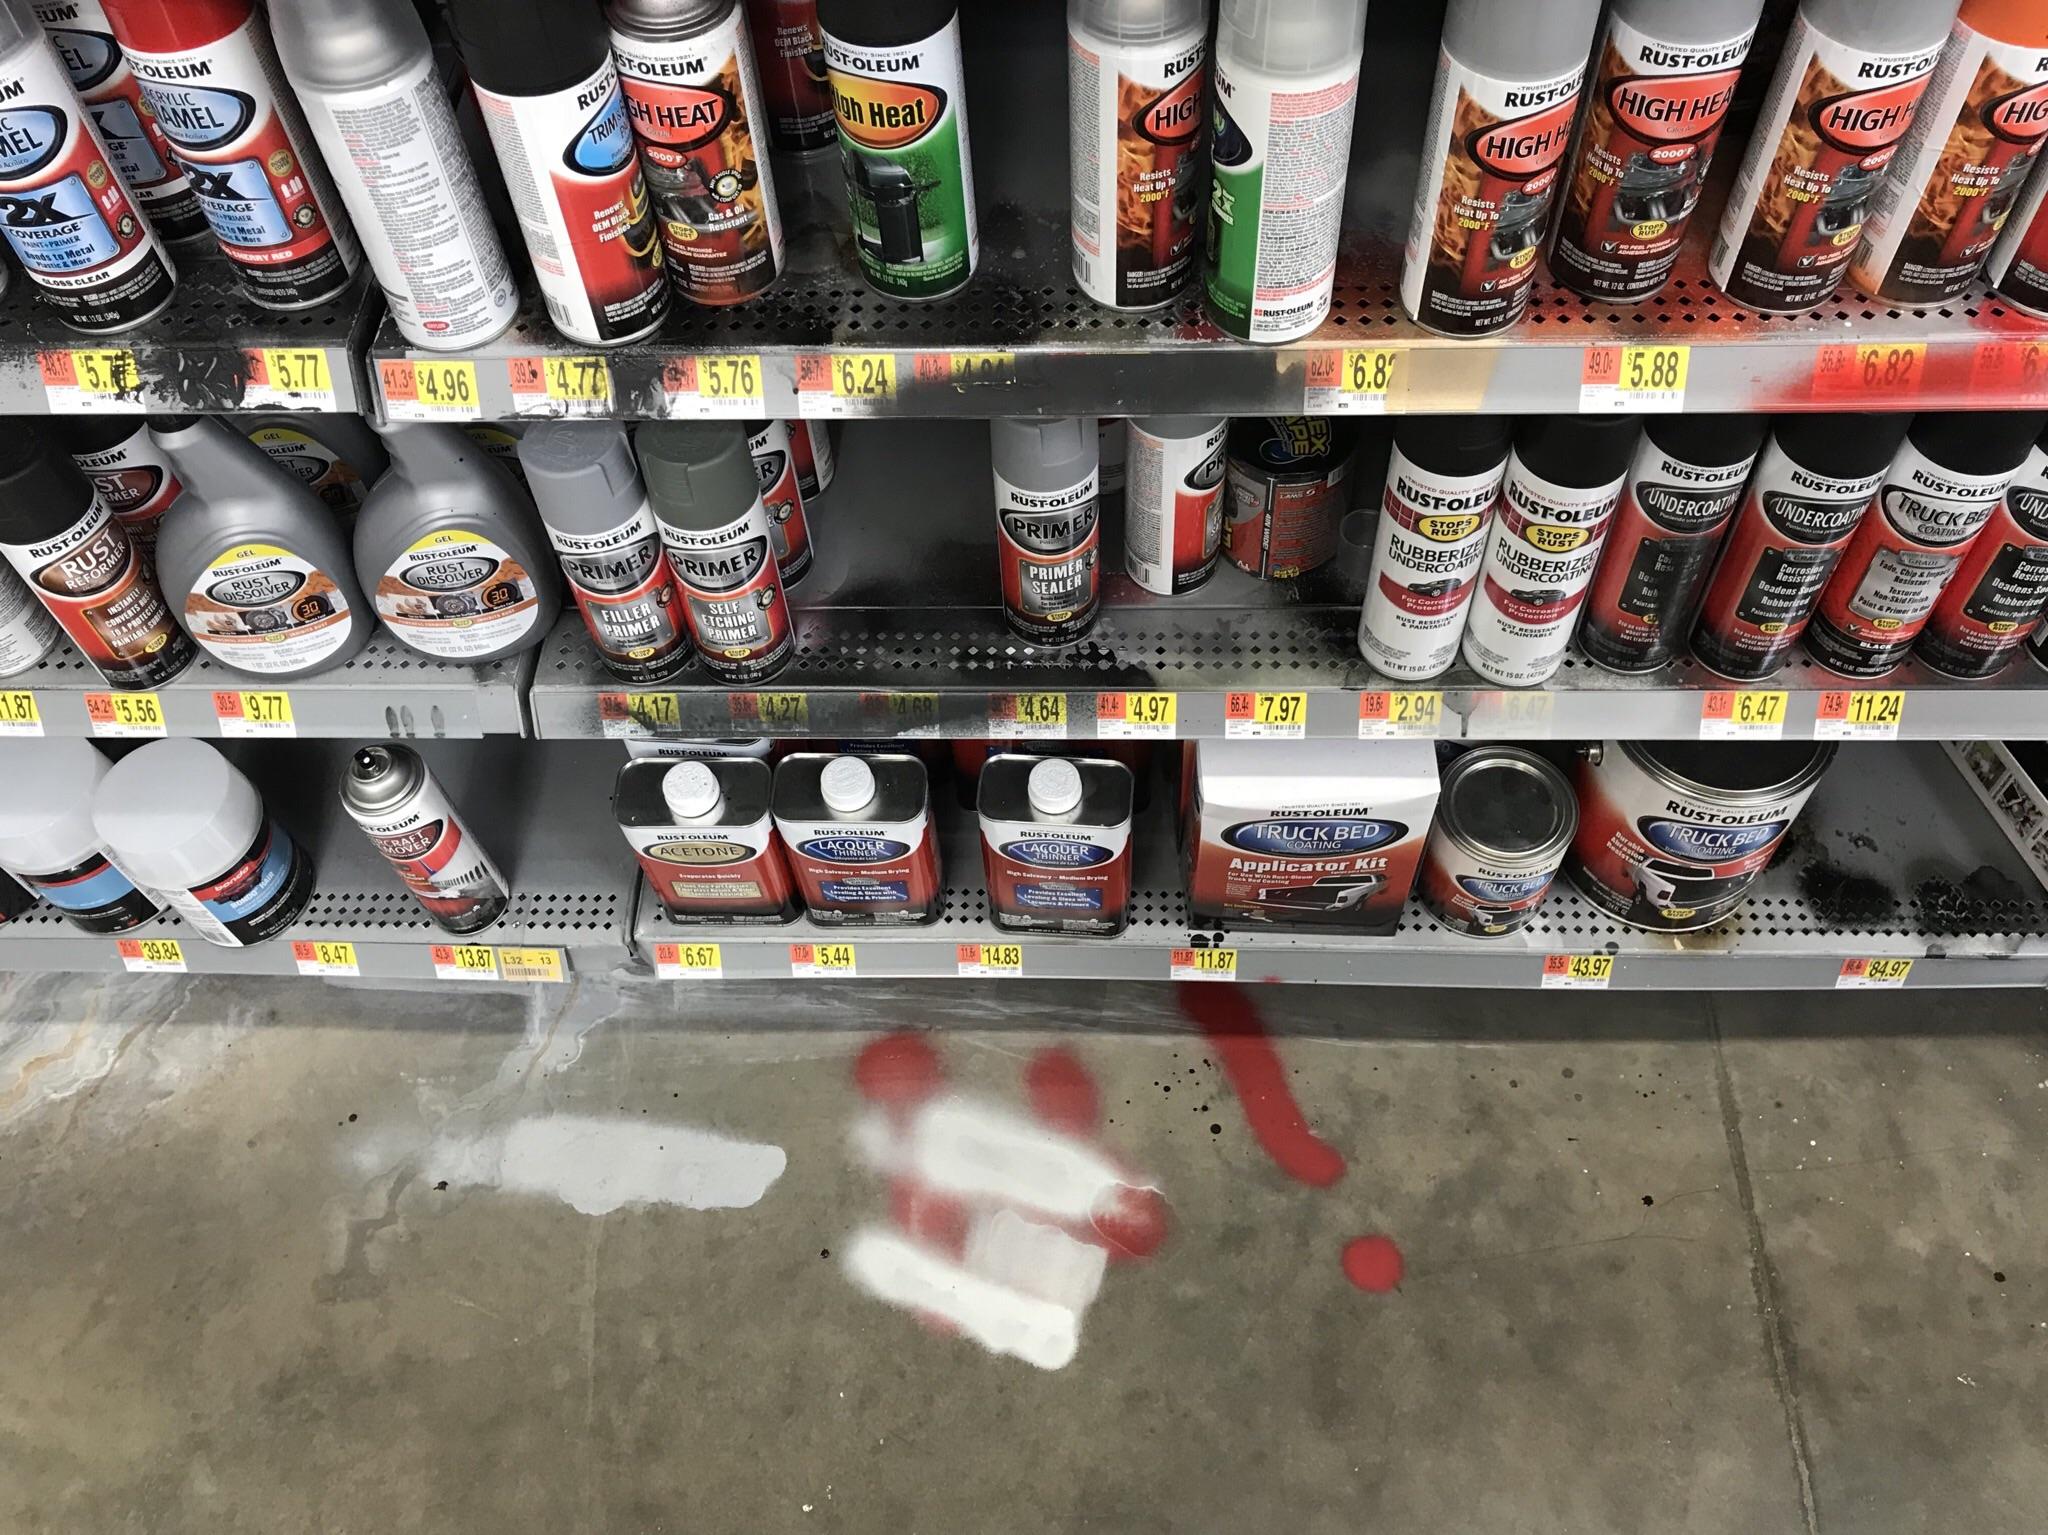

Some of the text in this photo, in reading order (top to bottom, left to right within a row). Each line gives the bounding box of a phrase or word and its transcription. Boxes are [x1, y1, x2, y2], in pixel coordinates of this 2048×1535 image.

[777, 24, 808, 36] Renews
[780, 45, 813, 58] Finishes
[656, 97, 719, 128] HEAT
[868, 98, 926, 129] Heat
[1617, 87, 1689, 122] HIGH
[1828, 104, 1902, 133] HIGH
[1485, 130, 1553, 160] HIGH
[1593, 143, 1622, 166] Resists
[1139, 168, 1171, 181] Resists
[1794, 164, 1830, 182] Resists
[1963, 162, 2000, 175] Resists
[1133, 180, 1167, 193] Heat Up
[1783, 173, 1806, 191] Heat
[1951, 172, 1974, 185] Heat
[593, 201, 625, 219] Renews
[1461, 195, 1496, 210] Resists
[708, 209, 725, 222] Gas
[1453, 205, 1488, 221] Heat Up
[9, 221, 82, 240] COVERAGE
[599, 223, 631, 243] Finishes
[708, 216, 749, 232] Resistant
[1637, 222, 1665, 231] STOPS
[1638, 228, 1662, 237] RUST
[64, 244, 96, 259] Metal
[42, 271, 111, 287] GLOSS CLEAR
[1262, 301, 1314, 318] RUST-OLEUM
[270, 353, 320, 389] $5.77
[702, 357, 754, 396] $5.76
[1627, 351, 1679, 389] $5.88
[1860, 348, 1915, 387] $6.82
[383, 368, 414, 390] 41.3¢
[416, 368, 470, 403] $4.96
[836, 358, 889, 396] $6.24
[1912, 468, 2012, 498] RUST-OLEUM
[1010, 480, 1094, 509] RUST-OLEUM
[1396, 475, 1502, 512] RUST-OLEU
[1898, 492, 1964, 527] TRUCK
[28, 502, 104, 559] RUST-OLEUM
[1013, 505, 1095, 540] PRIMER
[1429, 517, 1473, 528] STOPS
[1430, 526, 1466, 537] RUST
[1917, 523, 1966, 537] COATING
[434, 535, 454, 544] GEL
[555, 520, 643, 550] RUST-OLEUM
[663, 521, 750, 546] RUST-OLEUM
[1536, 529, 1581, 540] STOPS
[1537, 536, 1575, 547] RUST
[59, 527, 119, 580] RUST
[236, 549, 256, 559] GEL
[408, 544, 478, 562] RUST-OLEUM
[670, 546, 759, 577] PRIMER
[1388, 549, 1483, 574] UNDERCOATIN
[64, 541, 126, 590] REFORMER
[212, 558, 282, 578] RUST-OLEUM
[426, 561, 466, 576] RUST
[566, 545, 654, 581] PRIMER
[1028, 558, 1084, 580] PRIMER
[1779, 562, 1824, 575] Corrosion
[230, 575, 272, 591] RUST
[416, 567, 484, 586] DISSOLVER
[1776, 571, 1821, 583] Resistant
[1893, 575, 1930, 587] Resistant
[1900, 568, 1919, 580] Chip
[222, 581, 292, 602] DISSOLVER
[1031, 574, 1083, 596] SEALER
[1758, 580, 1798, 596] Deadens
[1888, 586, 1923, 597] Textured
[1991, 577, 2034, 595] Deadens
[107, 588, 142, 616] INSTANTLY
[1418, 593, 1462, 606] Corrosion
[1760, 596, 1812, 609] Rubberized
[1872, 589, 1908, 603] Non-Skid
[601, 602, 651, 624] FILLER
[708, 601, 741, 615] SELF
[1406, 601, 1456, 611] Protection
[1507, 607, 1558, 620] Protection
[1516, 603, 1566, 614] Corrosion
[1884, 605, 1911, 615] Primer
[104, 604, 141, 629] CONVERTS
[701, 611, 756, 630] ETCHING
[1395, 613, 1458, 625] RUST RESISTANT
[1408, 620, 1451, 630] PAINTABLE
[603, 615, 661, 638] PRIMER
[706, 624, 758, 641] PRIMER
[1508, 627, 1554, 638] PAINTABLE
[1518, 623, 1561, 634] RESISTANT
[112, 627, 149, 648] PAINTABLE
[1860, 641, 1893, 651] BLACK
[115, 699, 157, 724] $5.56
[245, 695, 284, 722] $9.77
[631, 695, 673, 723] $4.17
[760, 695, 801, 723] $4.27
[1019, 694, 1061, 724] $4.64
[1128, 695, 1170, 723] $4.97
[1258, 695, 1301, 723] $7.97
[1394, 695, 1436, 723] $2.94
[1737, 695, 1780, 722] $6.47
[1850, 695, 1900, 722] $11.24
[1269, 807, 1370, 818] RUST-OLEUM
[1665, 799, 1789, 825] RUST-OLEUM
[656, 833, 730, 842] RUST-OLEUM
[813, 828, 887, 838] RUST-OLEUM
[1019, 830, 1093, 842] RUST-OLEUM
[1253, 823, 1381, 842] TRUCK BED
[1667, 824, 1769, 847] TRUCK BED
[817, 838, 886, 854] LACQUER
[1022, 842, 1090, 856] LACQUER
[1285, 840, 1343, 850] COATING
[1610, 836, 1645, 862] Abrasion
[1615, 830, 1646, 854] Durable
[658, 845, 741, 858] ACETONE
[832, 848, 878, 858] THINNER
[1034, 851, 1081, 862] THINNER
[823, 867, 911, 877] Solvency Medium Drying
[1228, 856, 1390, 874] Applicator Kit
[1477, 862, 1554, 880] RUST-OLEUM
[214, 864, 250, 893] bondo
[679, 872, 716, 881] Evaporates
[1022, 871, 1109, 882] Solvency Medium Drying
[1261, 878, 1291, 886] Coating
[833, 884, 892, 892] Provides Excellent
[1028, 888, 1088, 898] Provides Excellent
[1478, 880, 1519, 894] TRUCK
[318, 943, 349, 964] $8.47
[454, 947, 492, 969] $13.87
[503, 955, 524, 967] L32
[683, 946, 714, 967] $6.67
[818, 946, 851, 966] $5.44
[981, 946, 1020, 967] $14.83
[1196, 951, 1234, 970] $11.87
[1571, 956, 1611, 978] $43.97
[1869, 961, 1911, 978] $84.97
